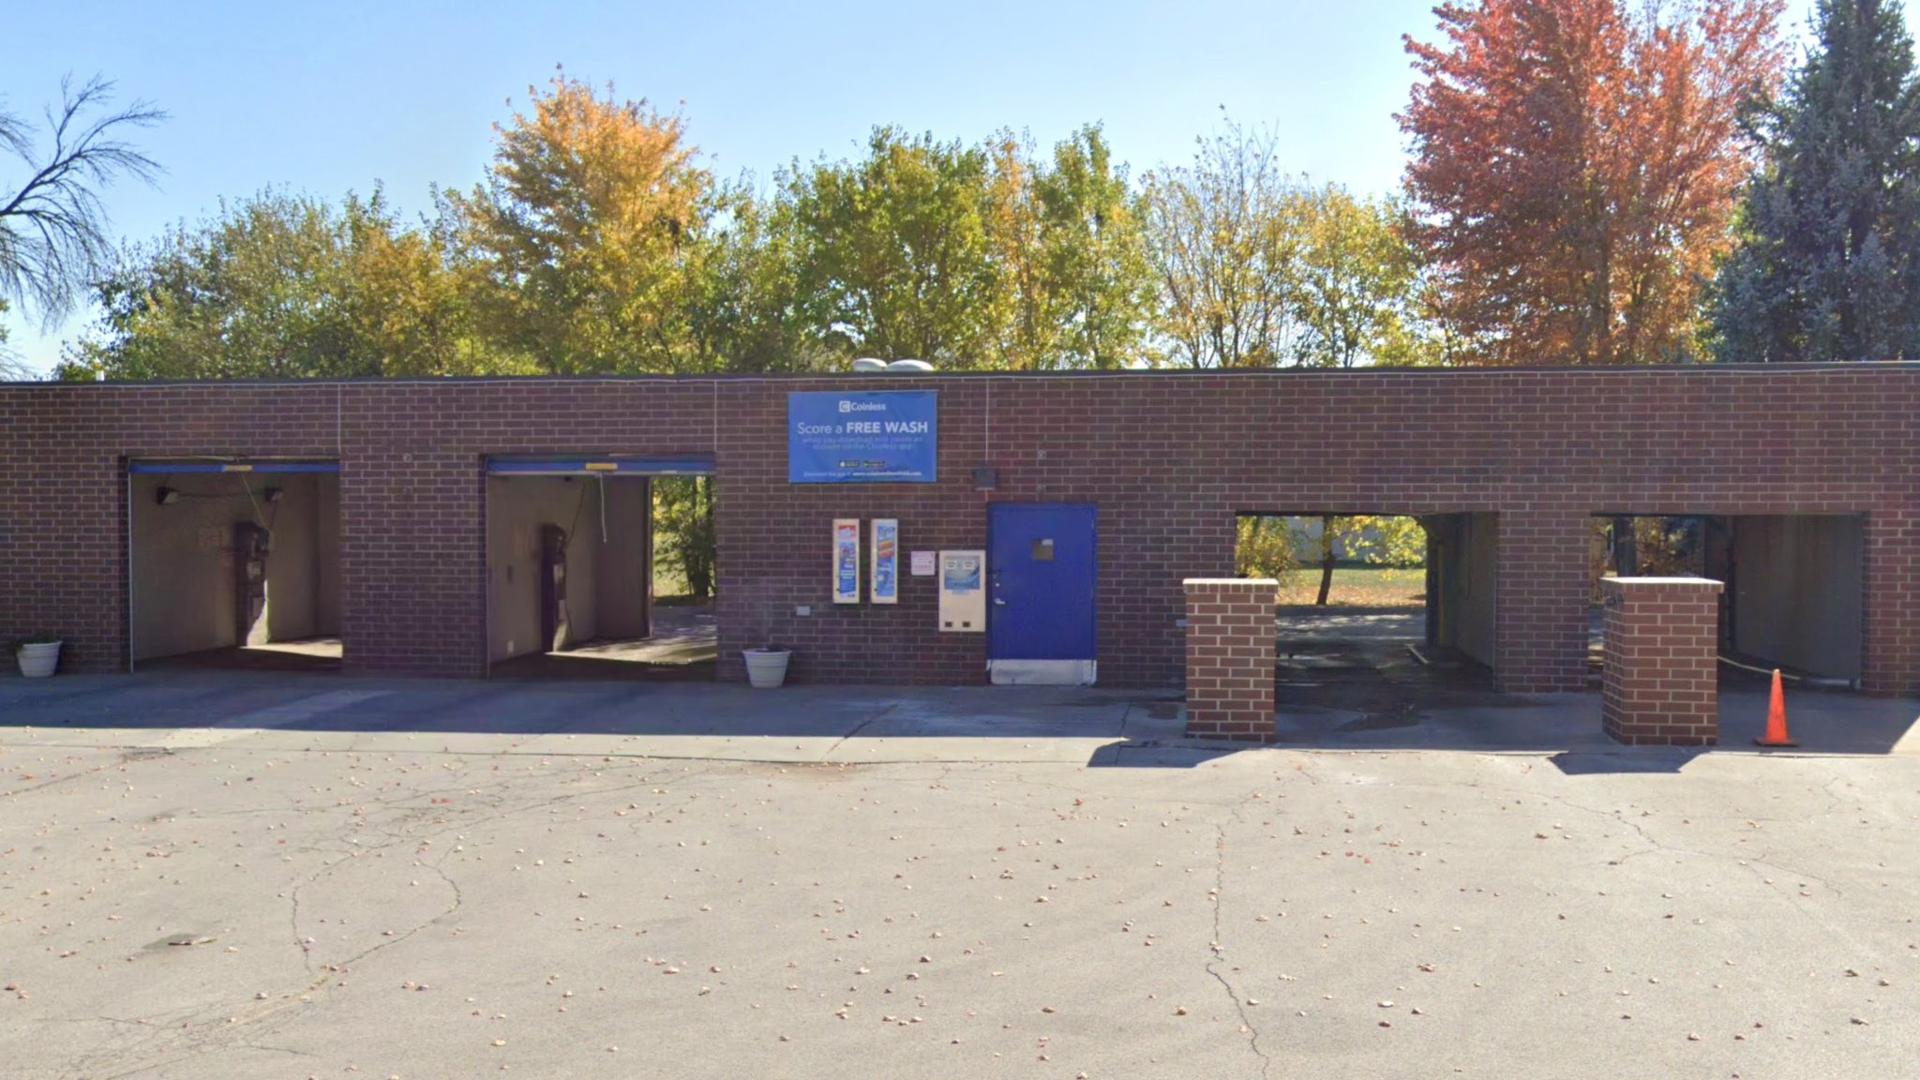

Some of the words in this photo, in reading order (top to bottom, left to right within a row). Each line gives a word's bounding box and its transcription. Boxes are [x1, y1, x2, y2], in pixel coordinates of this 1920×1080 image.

[798, 422, 832, 434] Score
[835, 425, 843, 434] a
[847, 421, 881, 433] FREE
[885, 421, 928, 433] WASH
